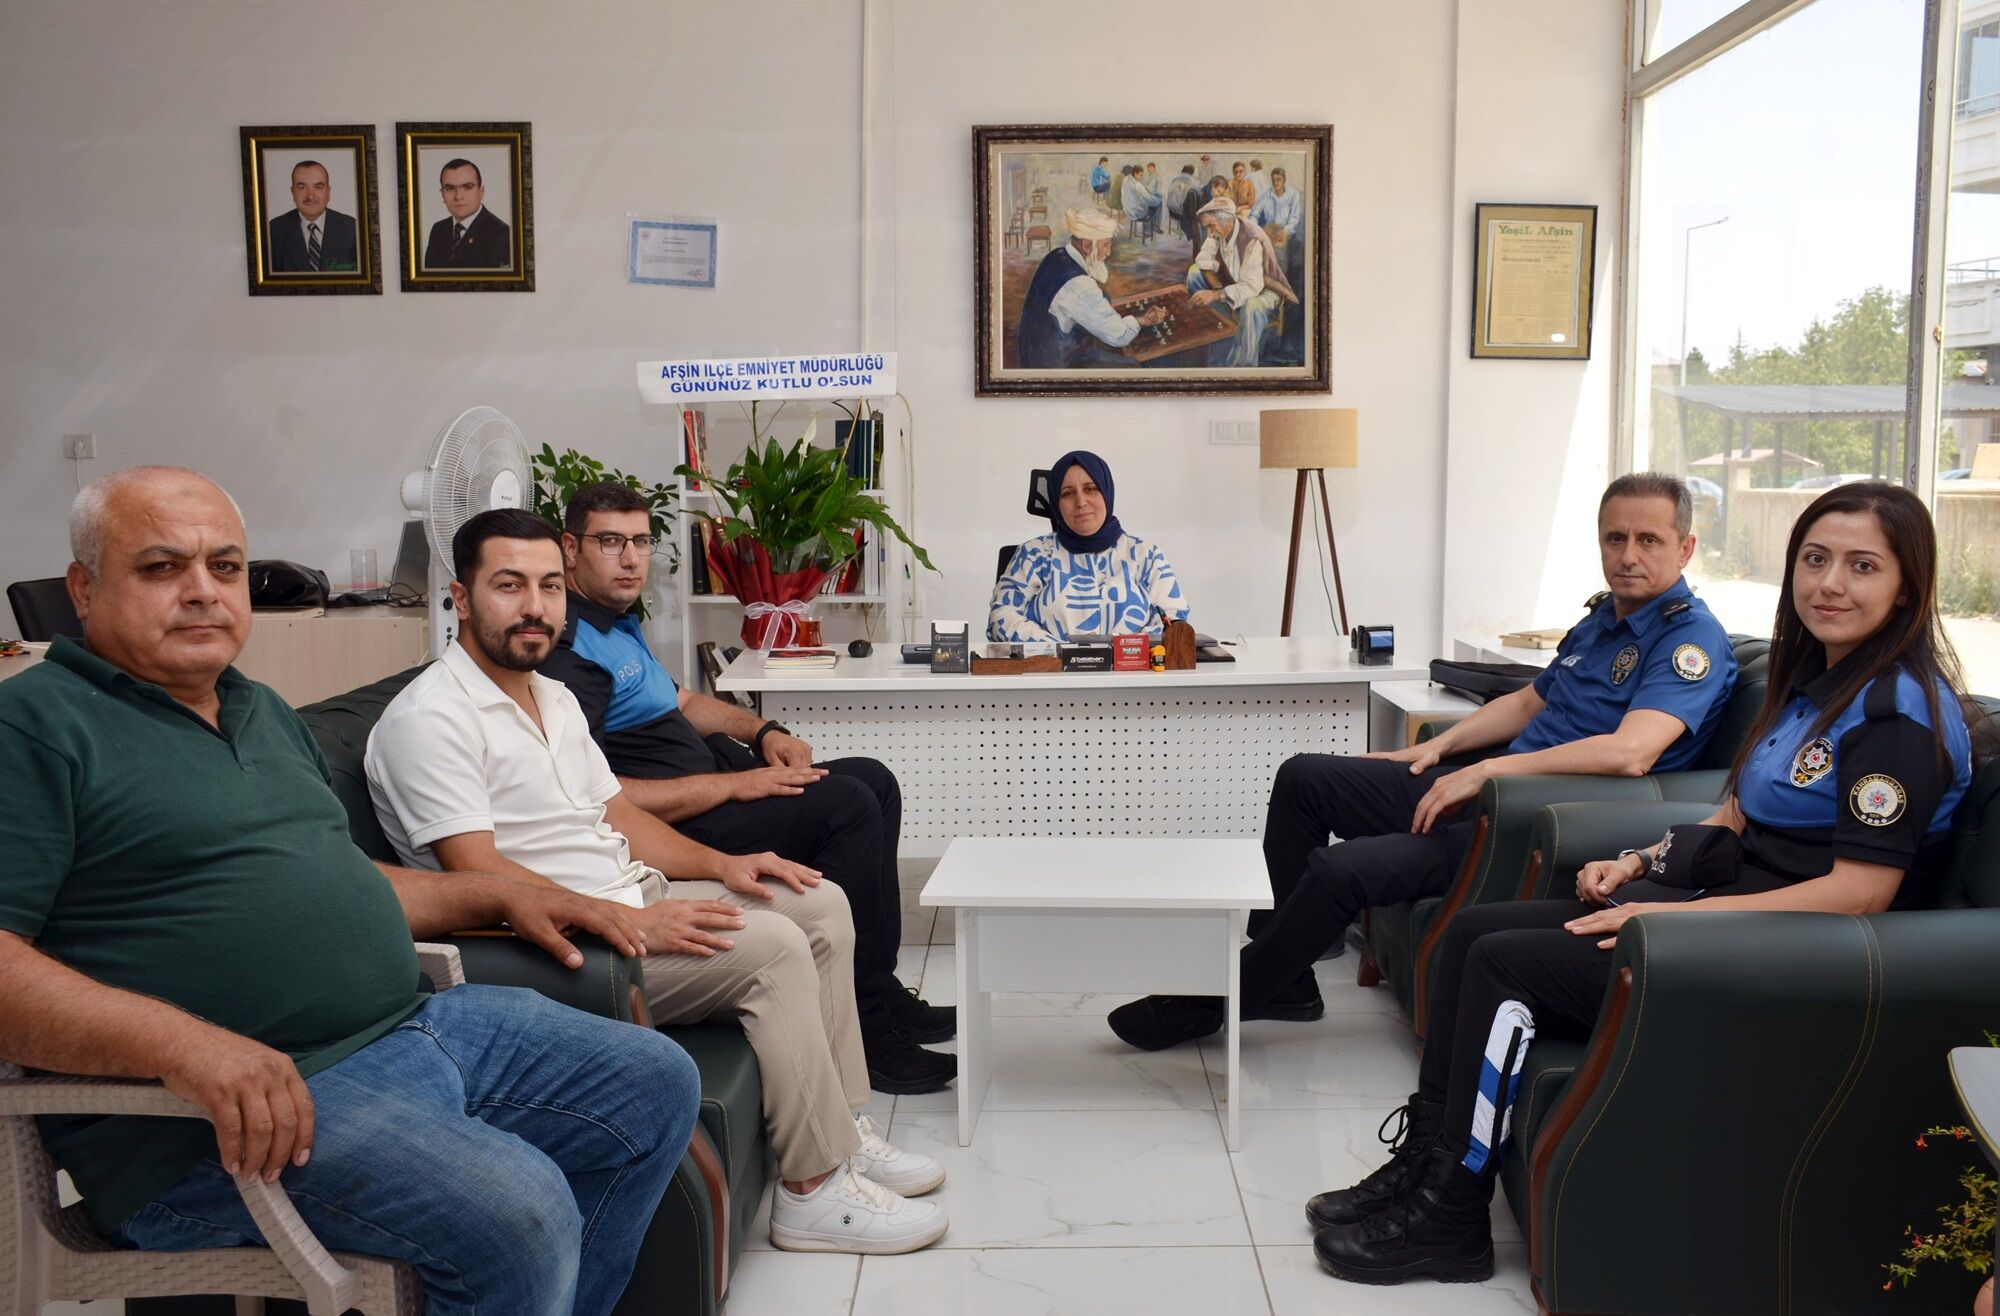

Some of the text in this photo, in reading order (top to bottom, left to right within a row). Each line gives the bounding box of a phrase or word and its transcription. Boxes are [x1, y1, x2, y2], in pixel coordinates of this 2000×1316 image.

[661, 362, 700, 381] AFŞİN
[737, 359, 796, 376] EMNİYET
[800, 354, 883, 374] MÜDÜRLÜĞÜ
[671, 375, 872, 393] GÜNÜNÜZ KUTLU OLSUN
